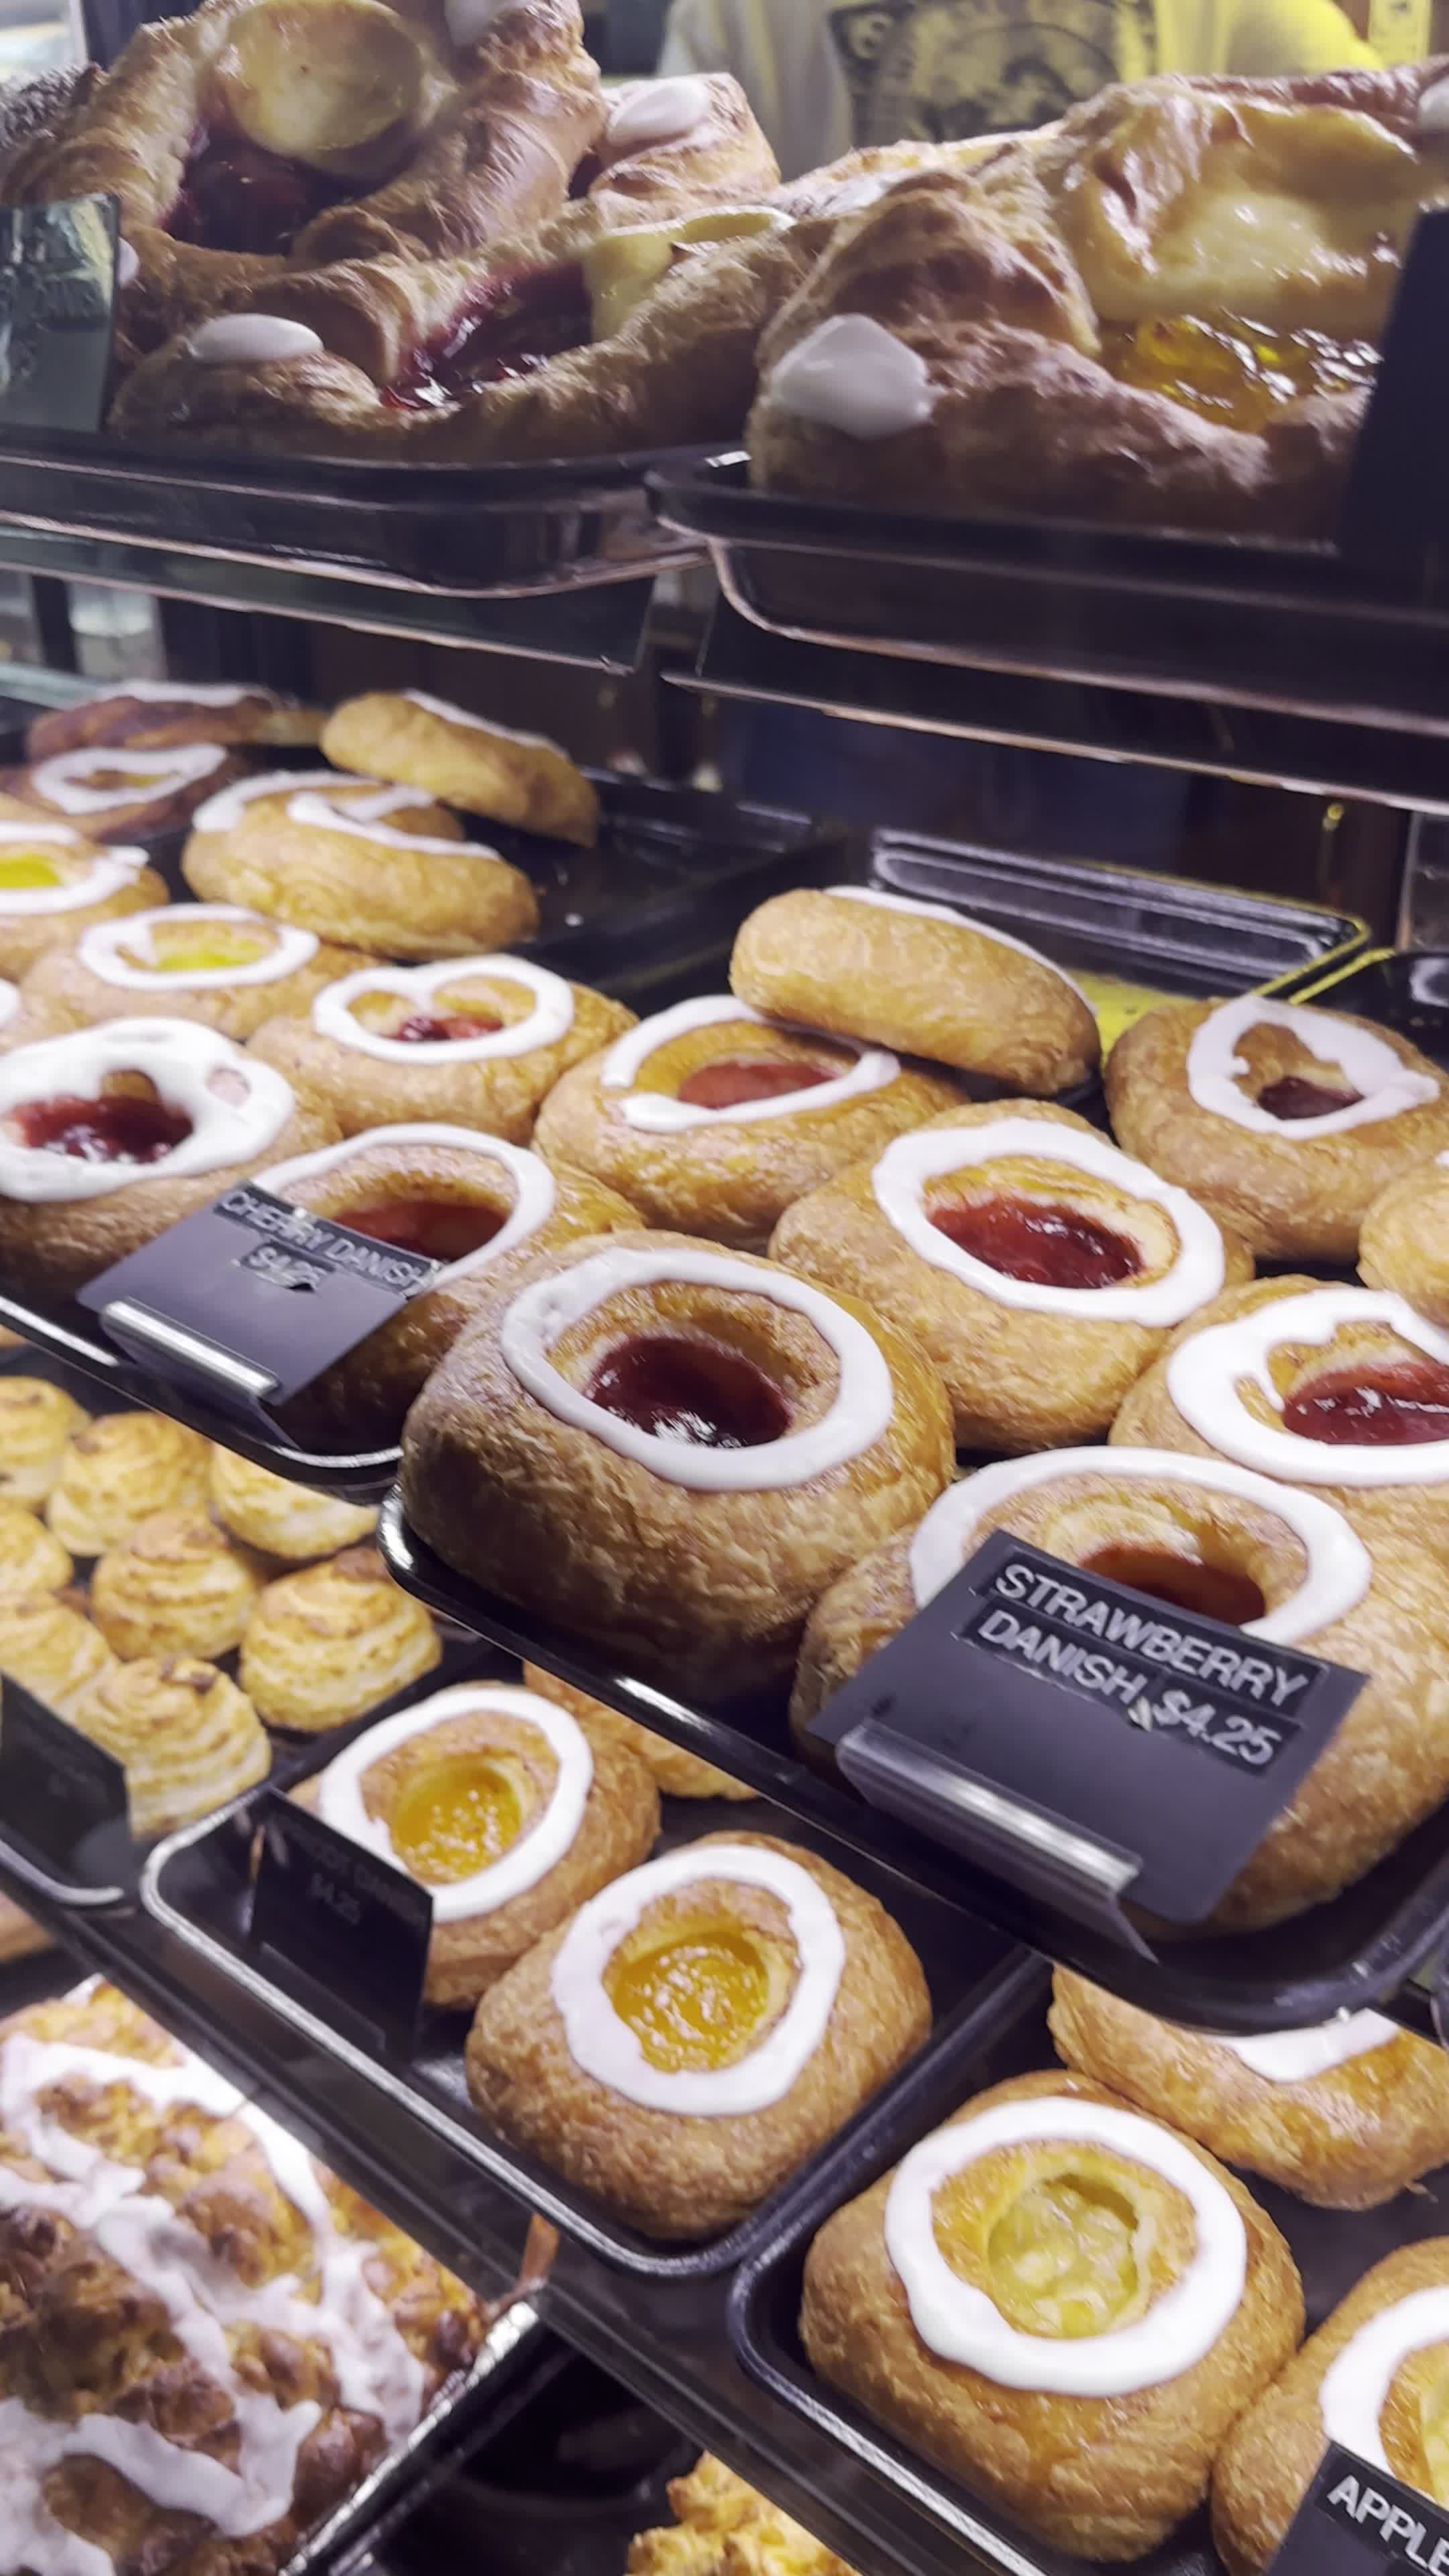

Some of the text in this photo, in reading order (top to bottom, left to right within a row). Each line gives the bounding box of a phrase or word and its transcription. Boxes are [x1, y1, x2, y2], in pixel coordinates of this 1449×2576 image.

[978, 1609, 1282, 1766] DANISH $4.25
[996, 1564, 1306, 1706] STRAWBERRY
